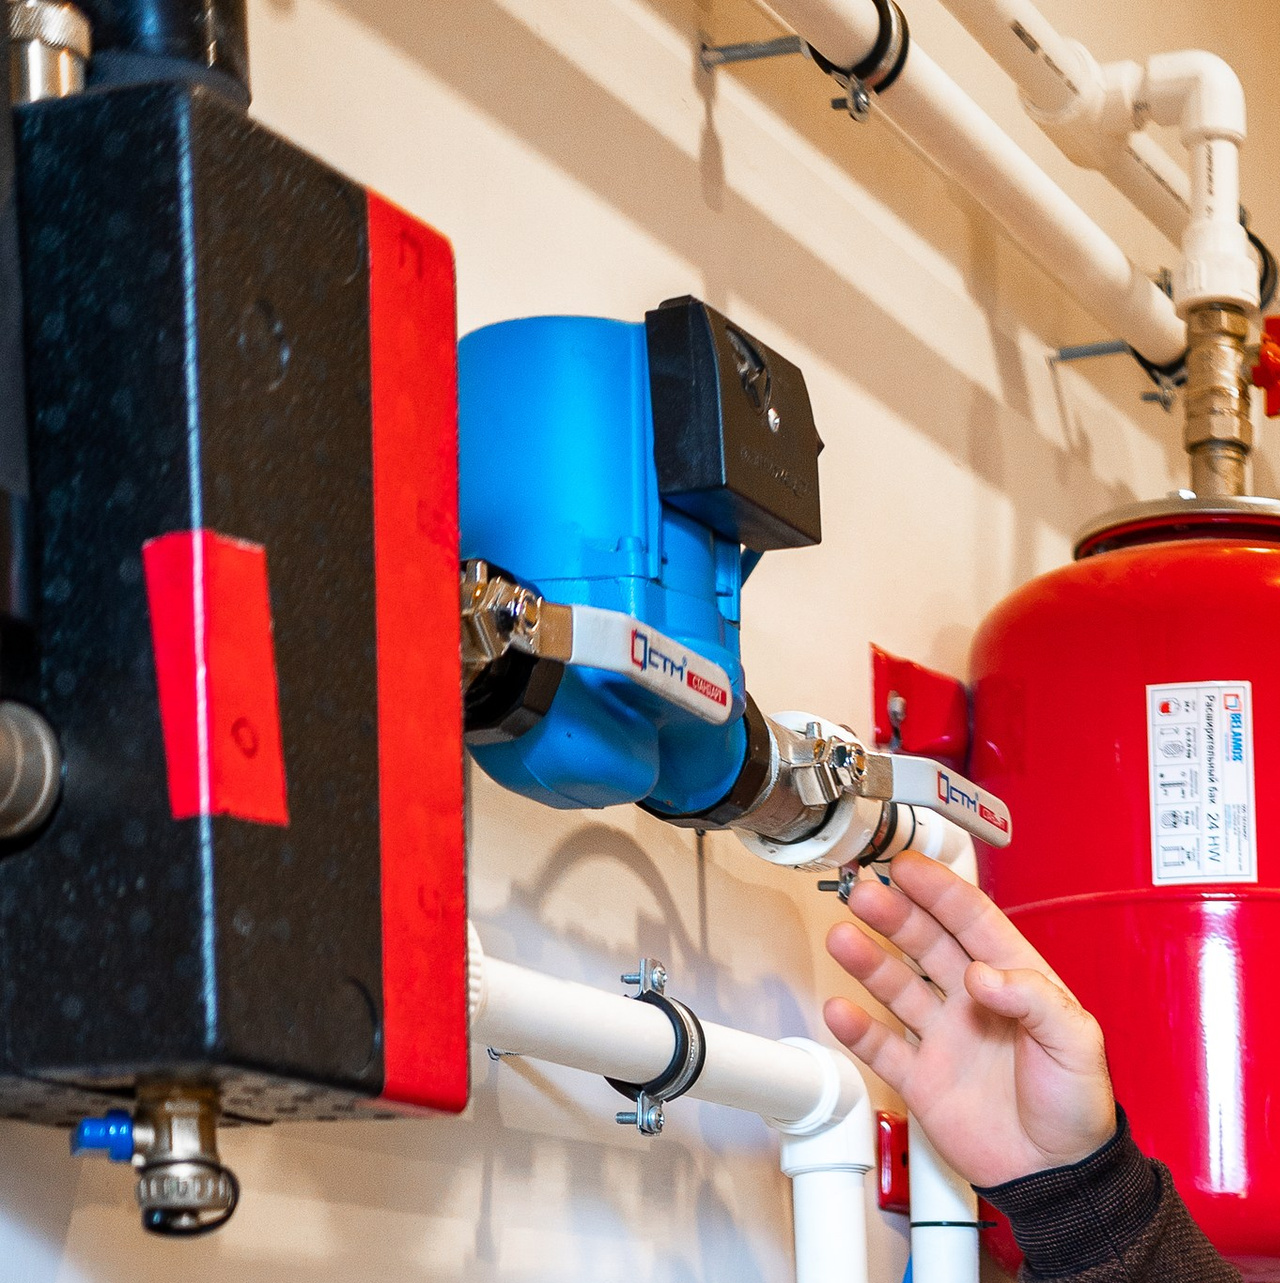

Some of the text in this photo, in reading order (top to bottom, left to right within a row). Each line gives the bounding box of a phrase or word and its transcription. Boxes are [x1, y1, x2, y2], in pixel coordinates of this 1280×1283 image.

[1204, 695, 1221, 862] Расширительный бак 24 HW
[1230, 713, 1244, 761] BELAMOS
